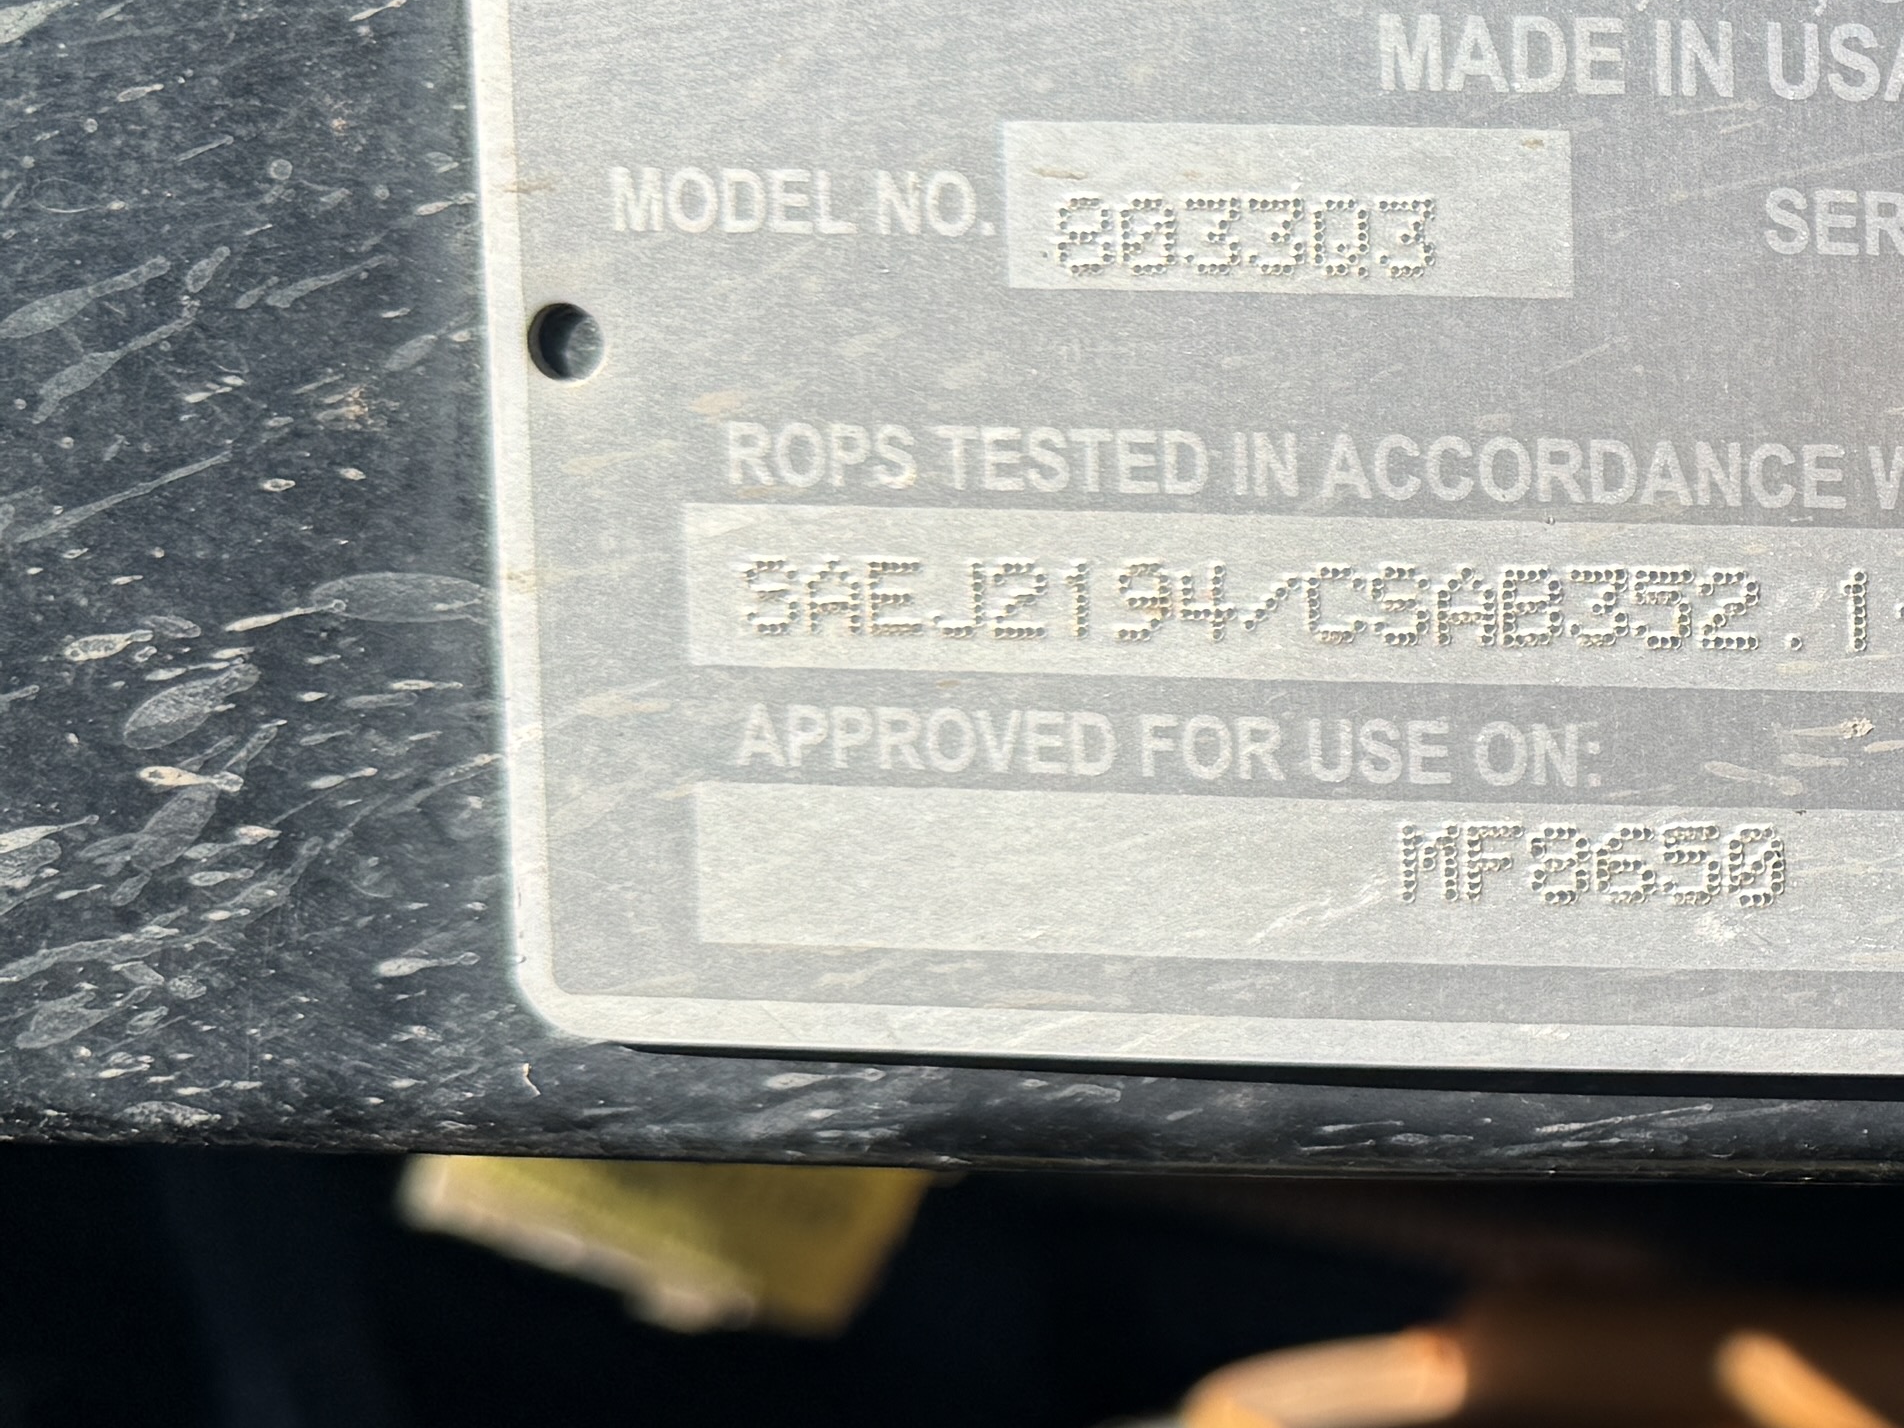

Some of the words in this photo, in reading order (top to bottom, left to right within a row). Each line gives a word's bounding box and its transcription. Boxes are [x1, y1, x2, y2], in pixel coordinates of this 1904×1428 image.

[1379, 13, 1624, 97] MADE
[1656, 20, 1732, 98] IN
[612, 166, 857, 235] MODEL
[877, 169, 996, 237] NO.
[728, 420, 914, 490] ROPS
[932, 424, 1205, 497] TESTED
[1232, 430, 1299, 495] IN
[1319, 433, 1842, 512] ACCORDANCE
[736, 701, 1117, 779] APPROVED
[1140, 711, 1283, 781] FOR
[1304, 716, 1450, 787] USE
[1473, 720, 1602, 789] ON:
[1397, 818, 1787, 908] MF8650
